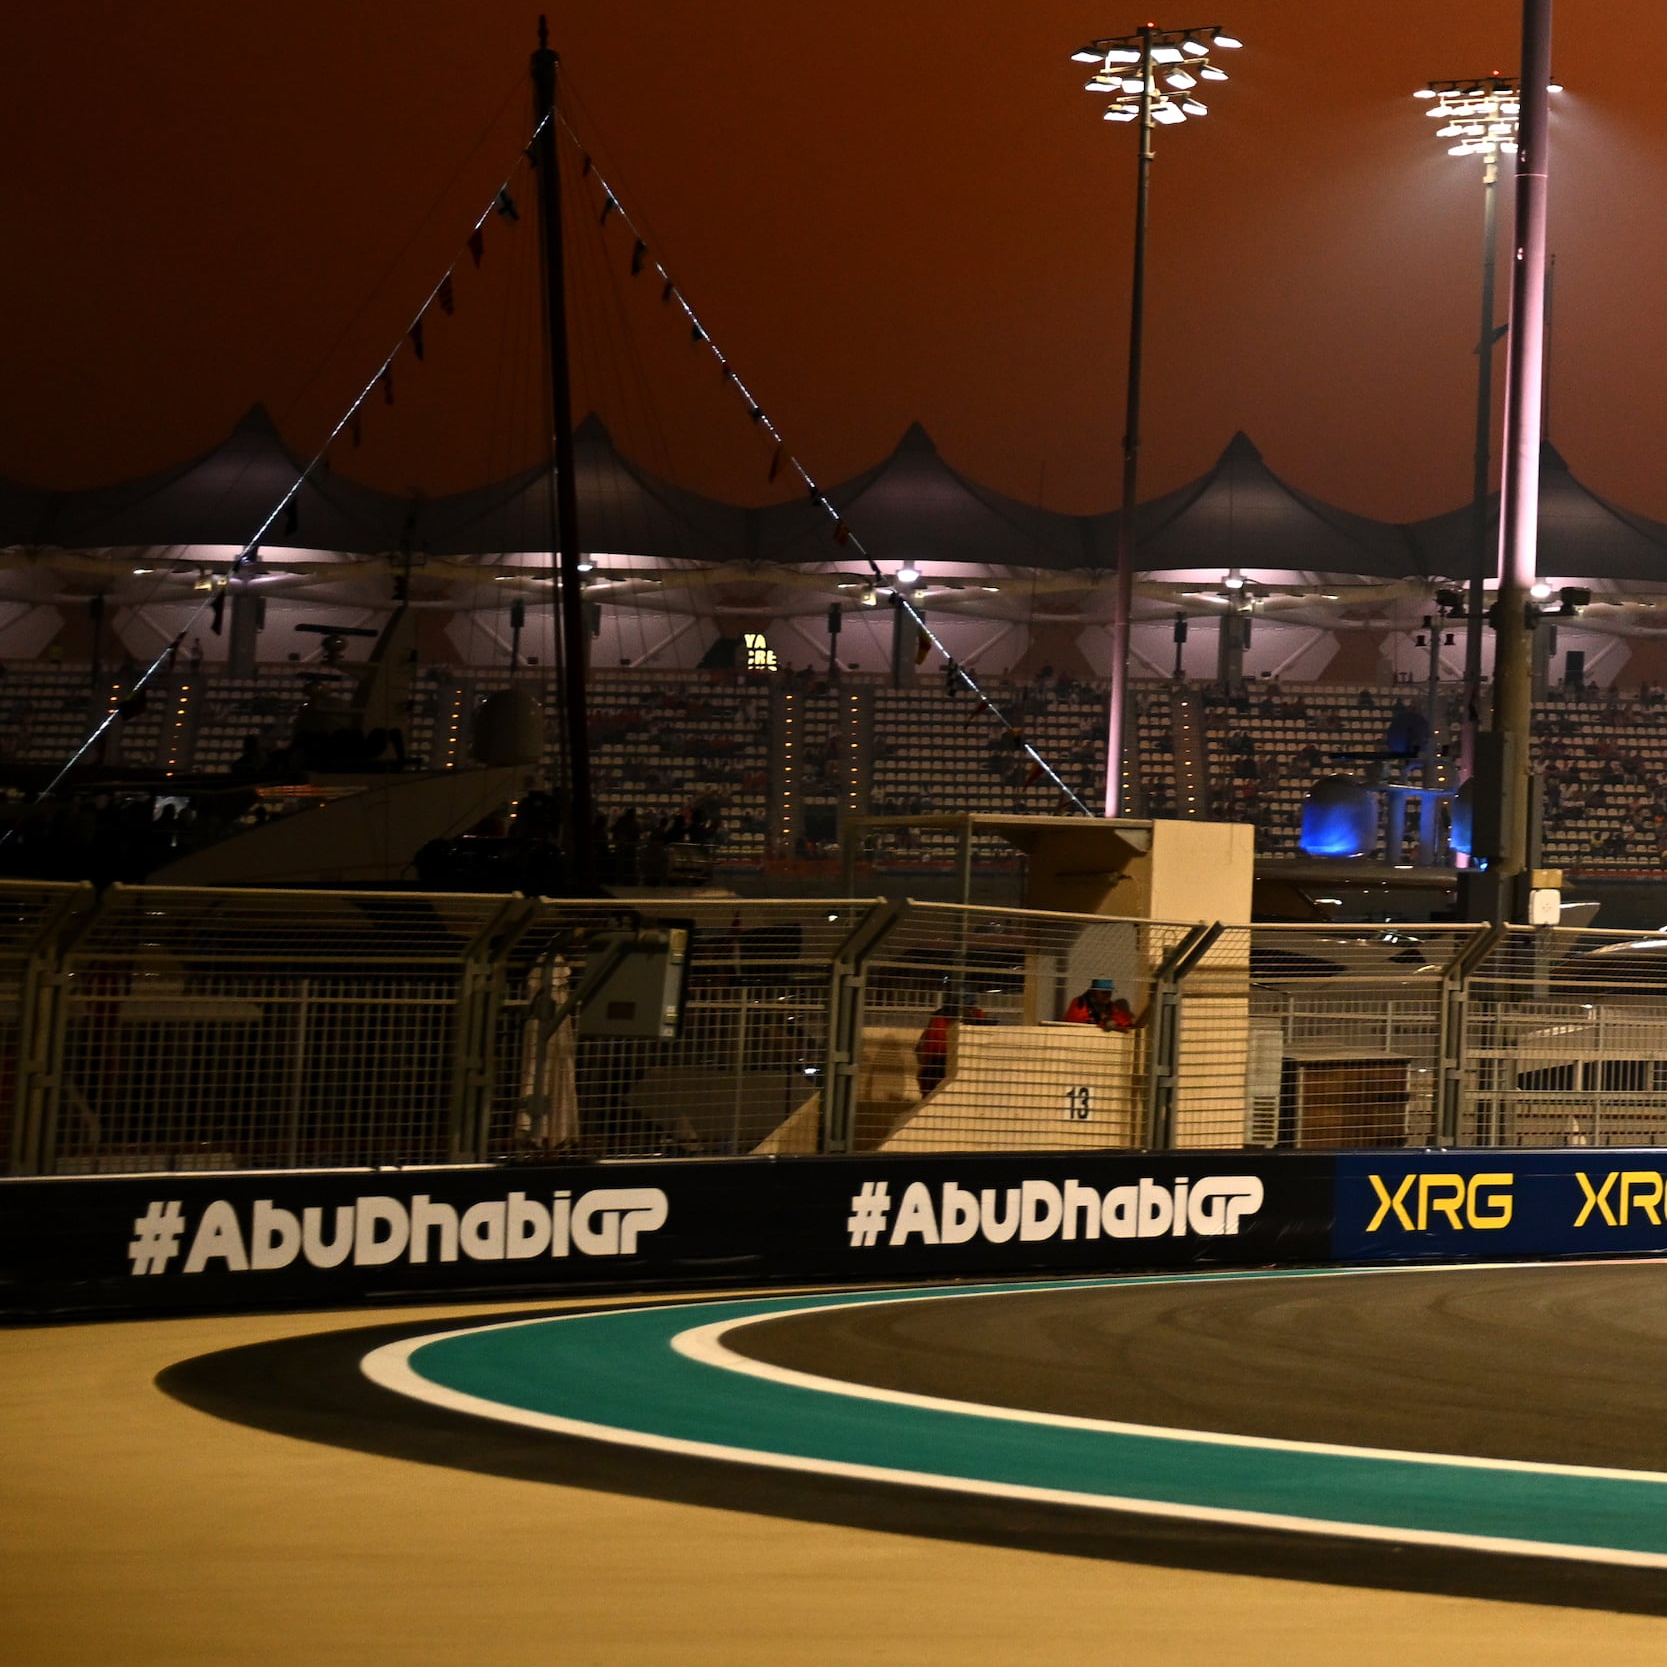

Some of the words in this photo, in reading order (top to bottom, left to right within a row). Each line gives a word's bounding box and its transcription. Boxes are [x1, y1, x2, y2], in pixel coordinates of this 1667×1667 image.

[1067, 1086, 1089, 1119] 13
[127, 1187, 669, 1276] #AbuDhabiGP
[846, 1175, 1264, 1247] #AbuDhabiGP
[1365, 1172, 1515, 1233] XRG
